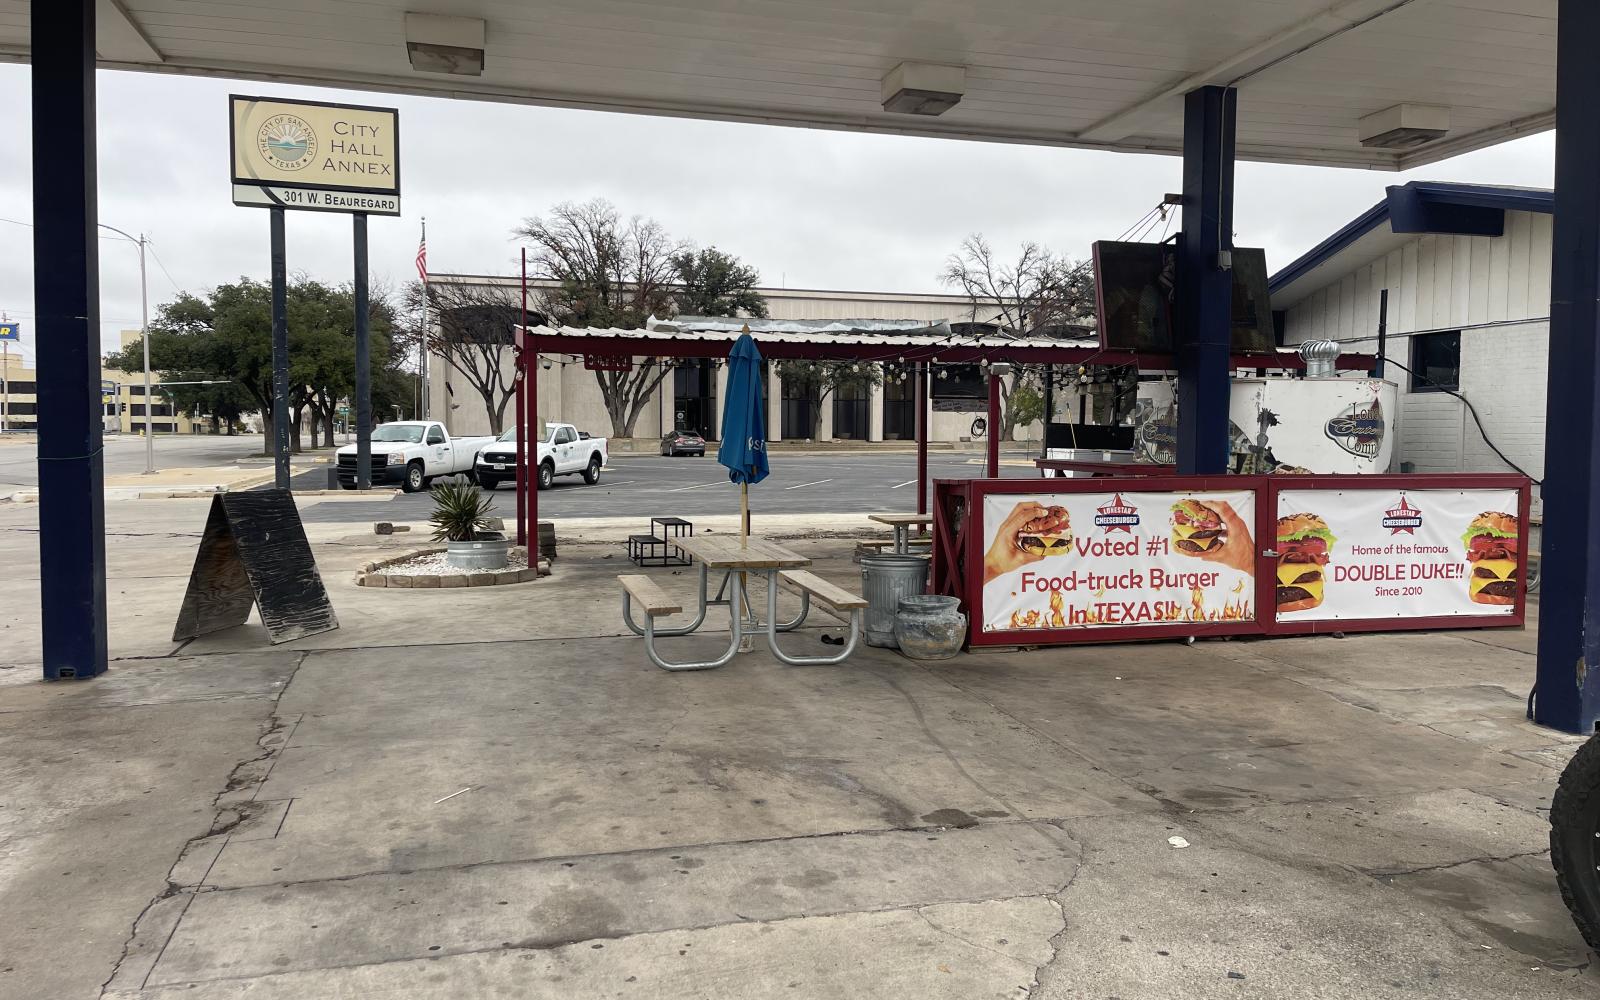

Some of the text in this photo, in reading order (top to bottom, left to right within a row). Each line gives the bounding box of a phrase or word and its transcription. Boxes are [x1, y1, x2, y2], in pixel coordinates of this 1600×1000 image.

[260, 116, 315, 156] THE CITY OF SAN ANGELO
[275, 159, 301, 168] TEXAS
[284, 190, 302, 203] 301
[307, 193, 321, 204] W.
[1103, 506, 1132, 514] LONESTAR
[1075, 535, 1169, 557] Voted #1
[1352, 544, 1449, 555] Home of the famous
[1021, 568, 1219, 592] Food-truck Burger
[1334, 563, 1465, 582] DOUBLE DUKE!!
[1375, 586, 1423, 596] Since 2010
[1068, 601, 1175, 625] In TEXAS!!
